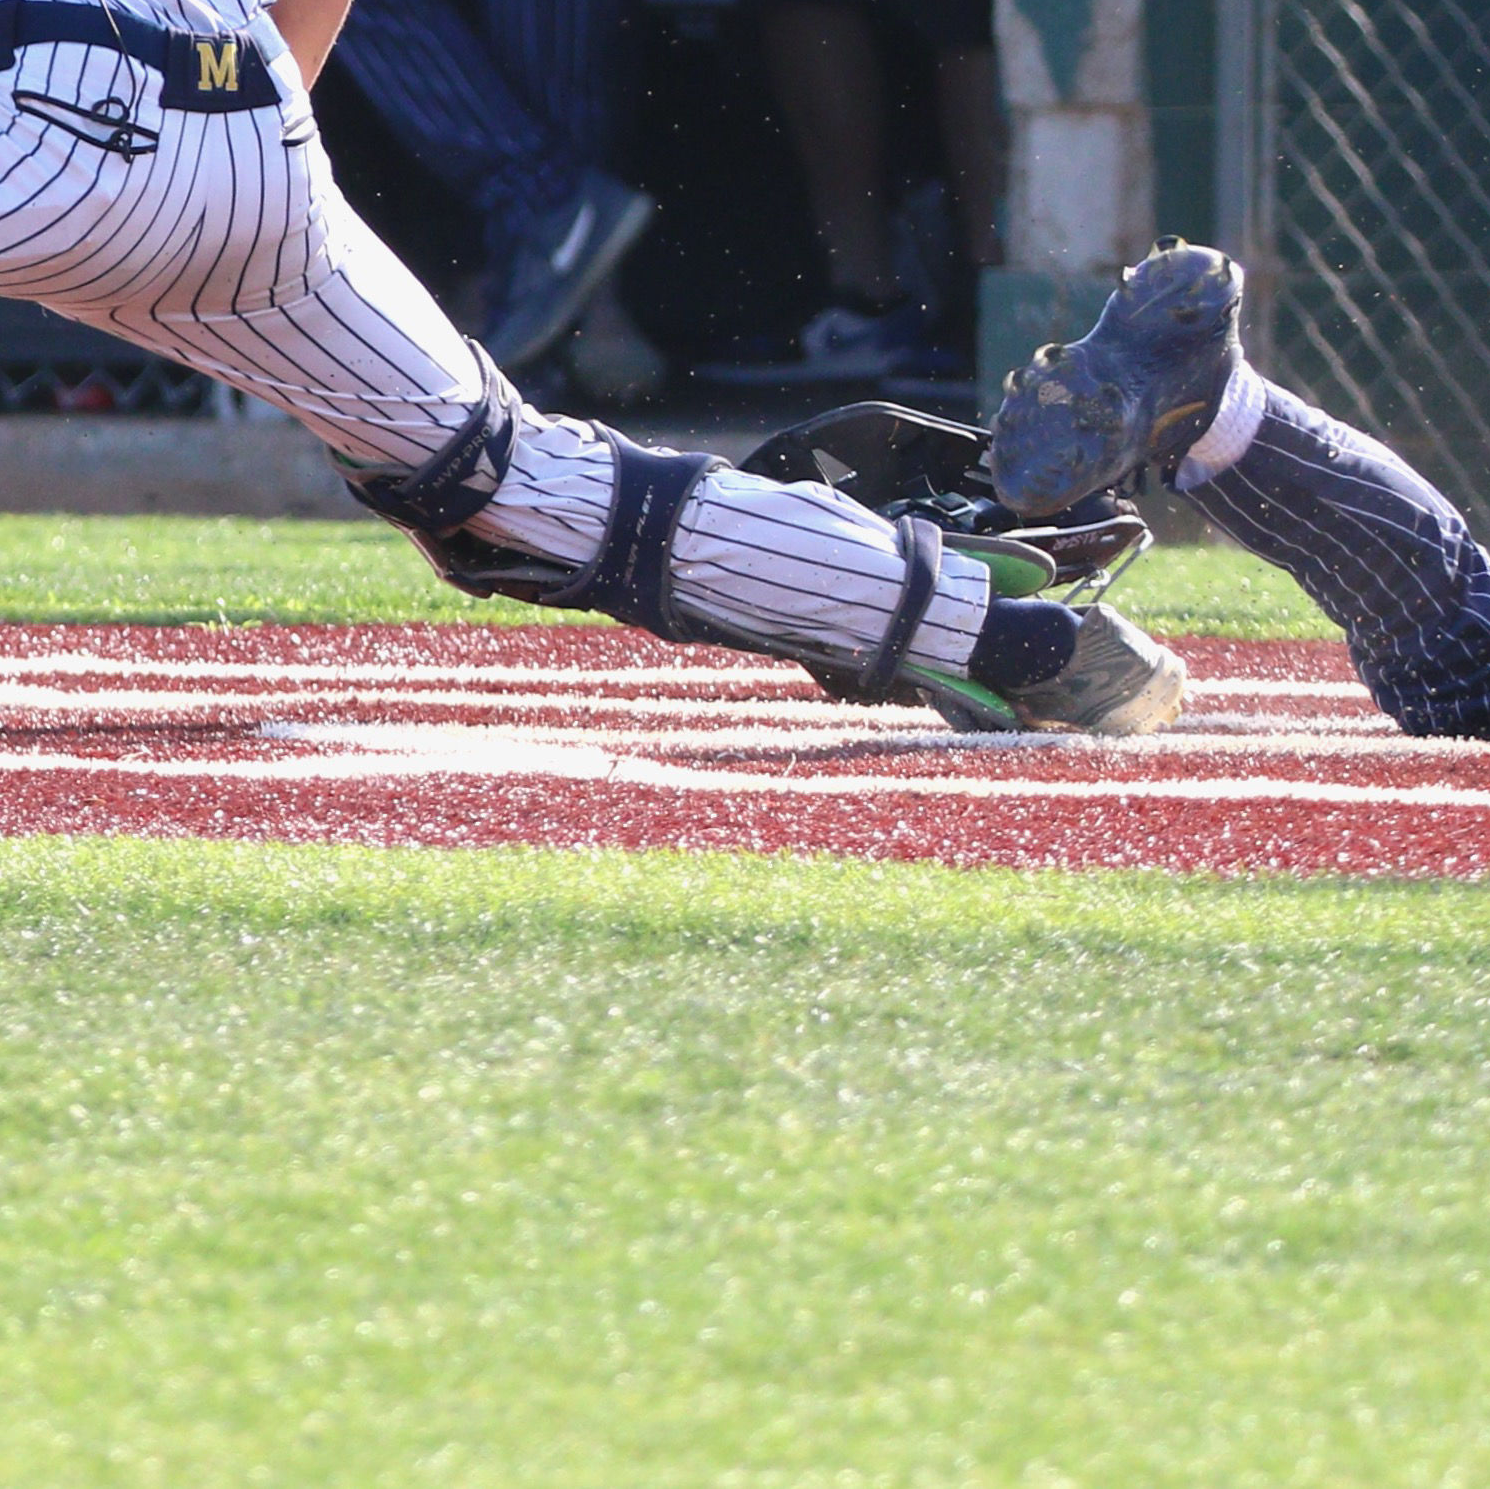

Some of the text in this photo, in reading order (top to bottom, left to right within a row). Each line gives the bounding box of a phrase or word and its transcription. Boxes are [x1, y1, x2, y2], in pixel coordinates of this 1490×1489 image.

[196, 41, 239, 92] M
[432, 424, 492, 489] MVP PRO
